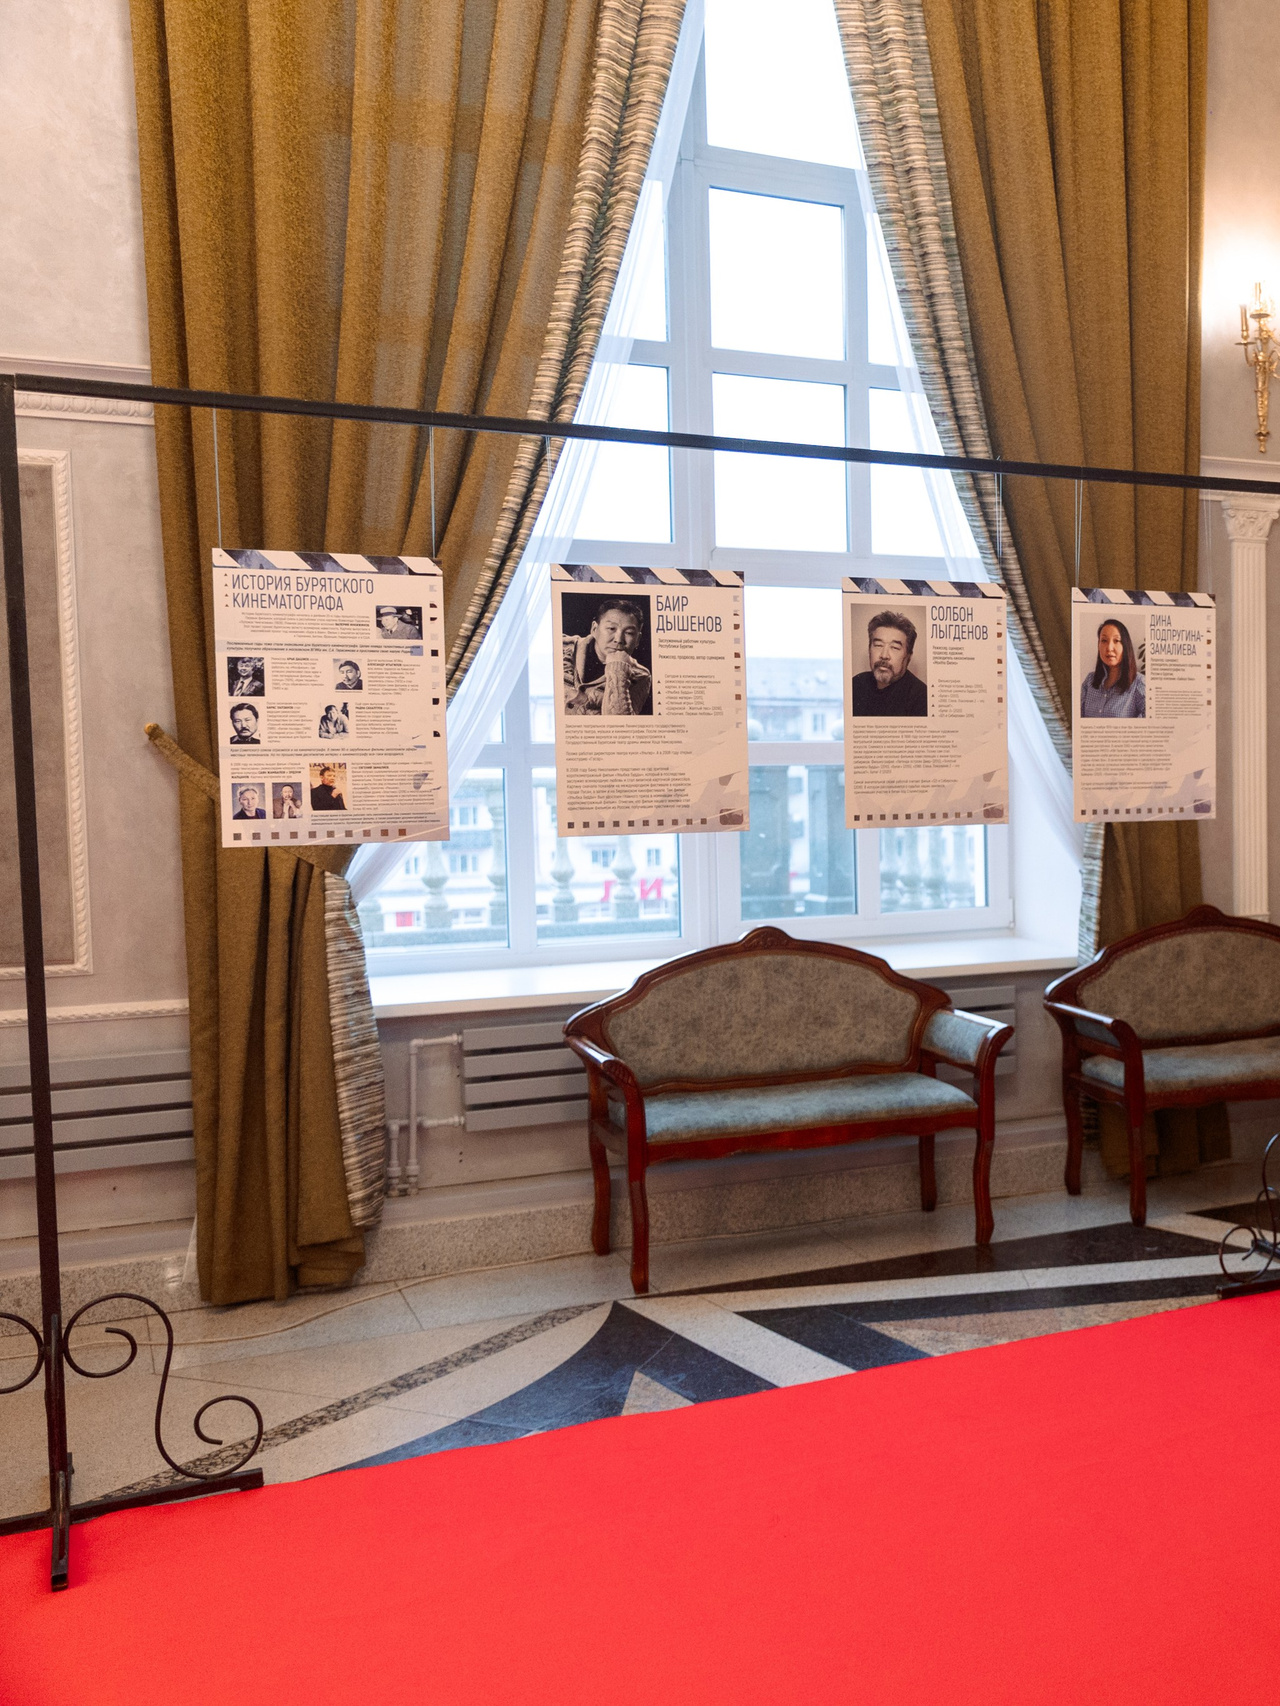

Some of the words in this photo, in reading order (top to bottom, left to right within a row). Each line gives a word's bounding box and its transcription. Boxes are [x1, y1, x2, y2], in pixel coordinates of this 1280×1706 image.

[231, 573, 292, 592] ИСТОРИЯ
[296, 576, 374, 594] БУРЯТСКОГО
[232, 593, 344, 611] КИНЕМАТОГРАФА
[656, 594, 689, 612] БАИР
[930, 605, 974, 622] СОЛБОН
[1149, 614, 1172, 629] ДИНА
[656, 614, 723, 634] ДЫШЕНОВ
[930, 624, 989, 641] ЛЫГДЕНОВ
[1149, 628, 1204, 644] ПОДПРУГИНА-
[1149, 642, 1197, 656] ЗАМАЛИЕВА
